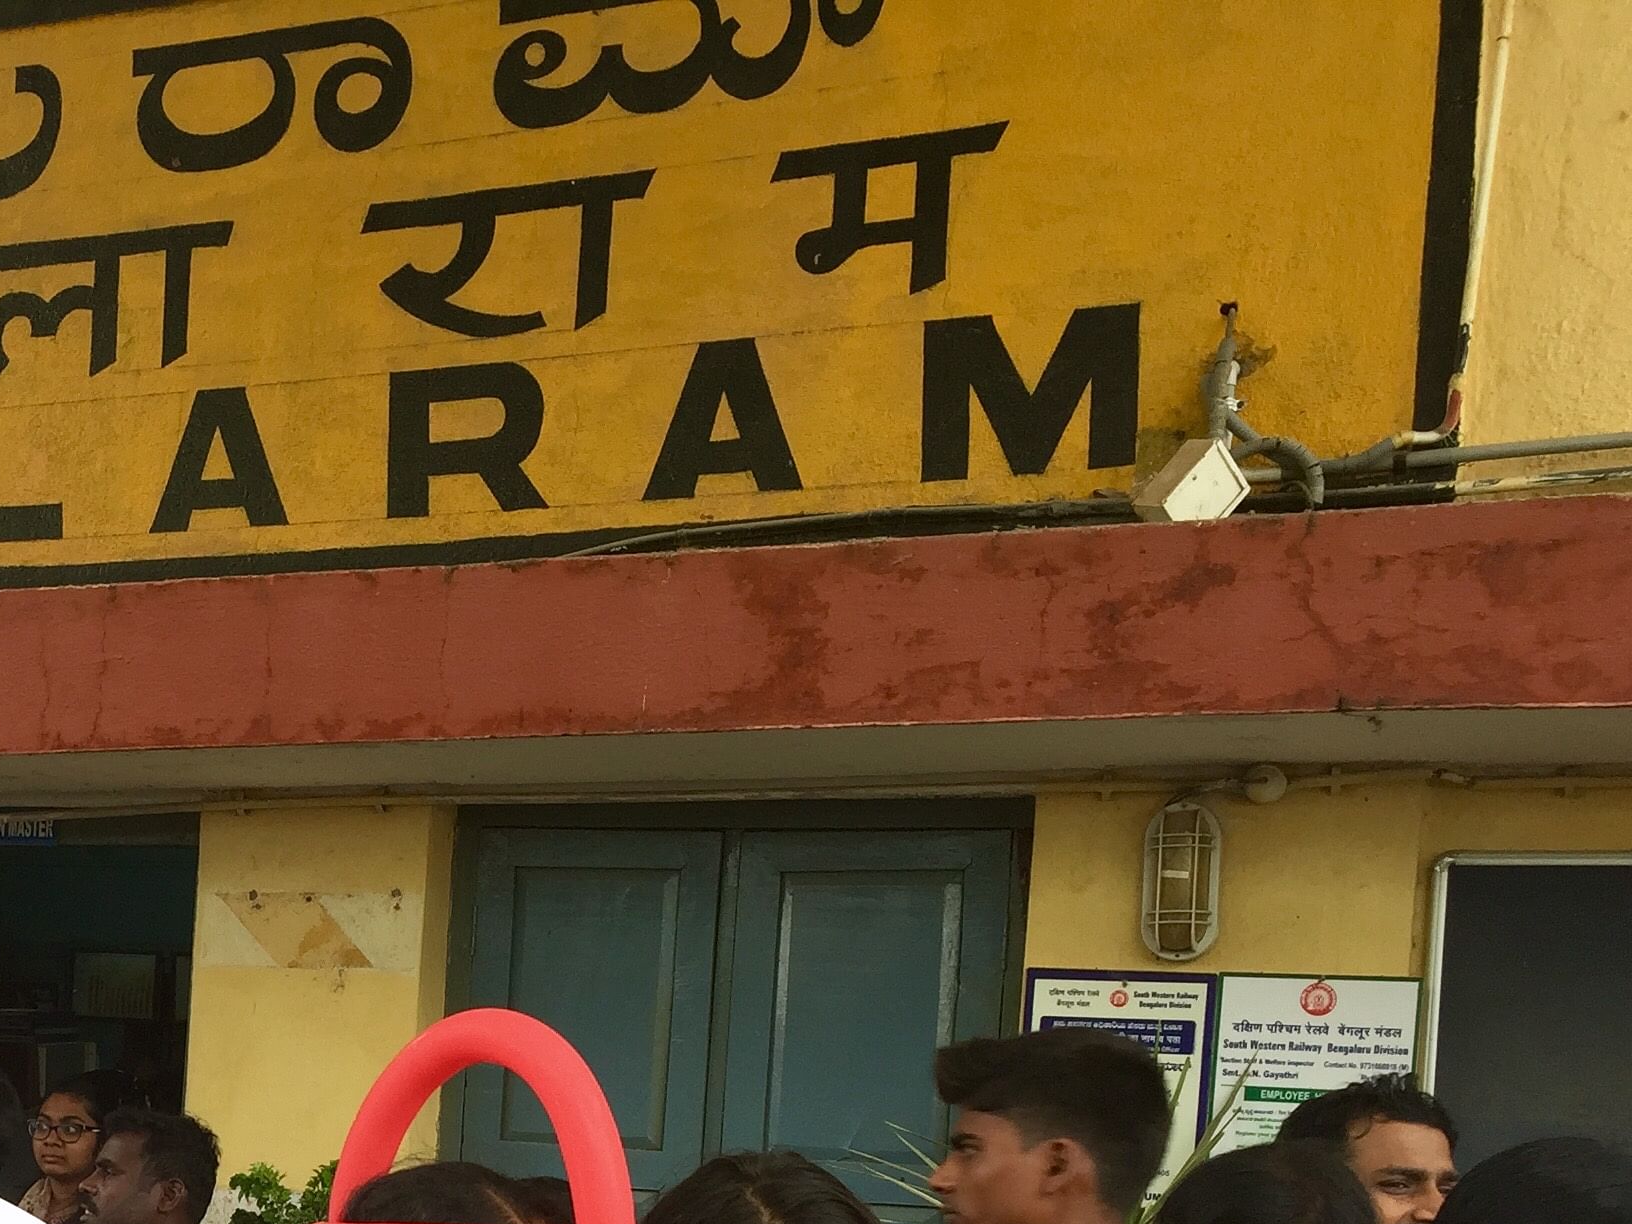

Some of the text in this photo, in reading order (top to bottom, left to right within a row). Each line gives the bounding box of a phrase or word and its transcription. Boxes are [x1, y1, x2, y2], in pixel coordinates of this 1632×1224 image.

[1232, 1019, 1262, 1033] दक्षिण
[1305, 1021, 1329, 1036] रेलवे
[1223, 1039, 1409, 1056] South Western Railway Bengaluru Division
[1263, 1070, 1298, 1080] Gayathri
[1260, 1089, 1310, 1100] EMPLOYEE
